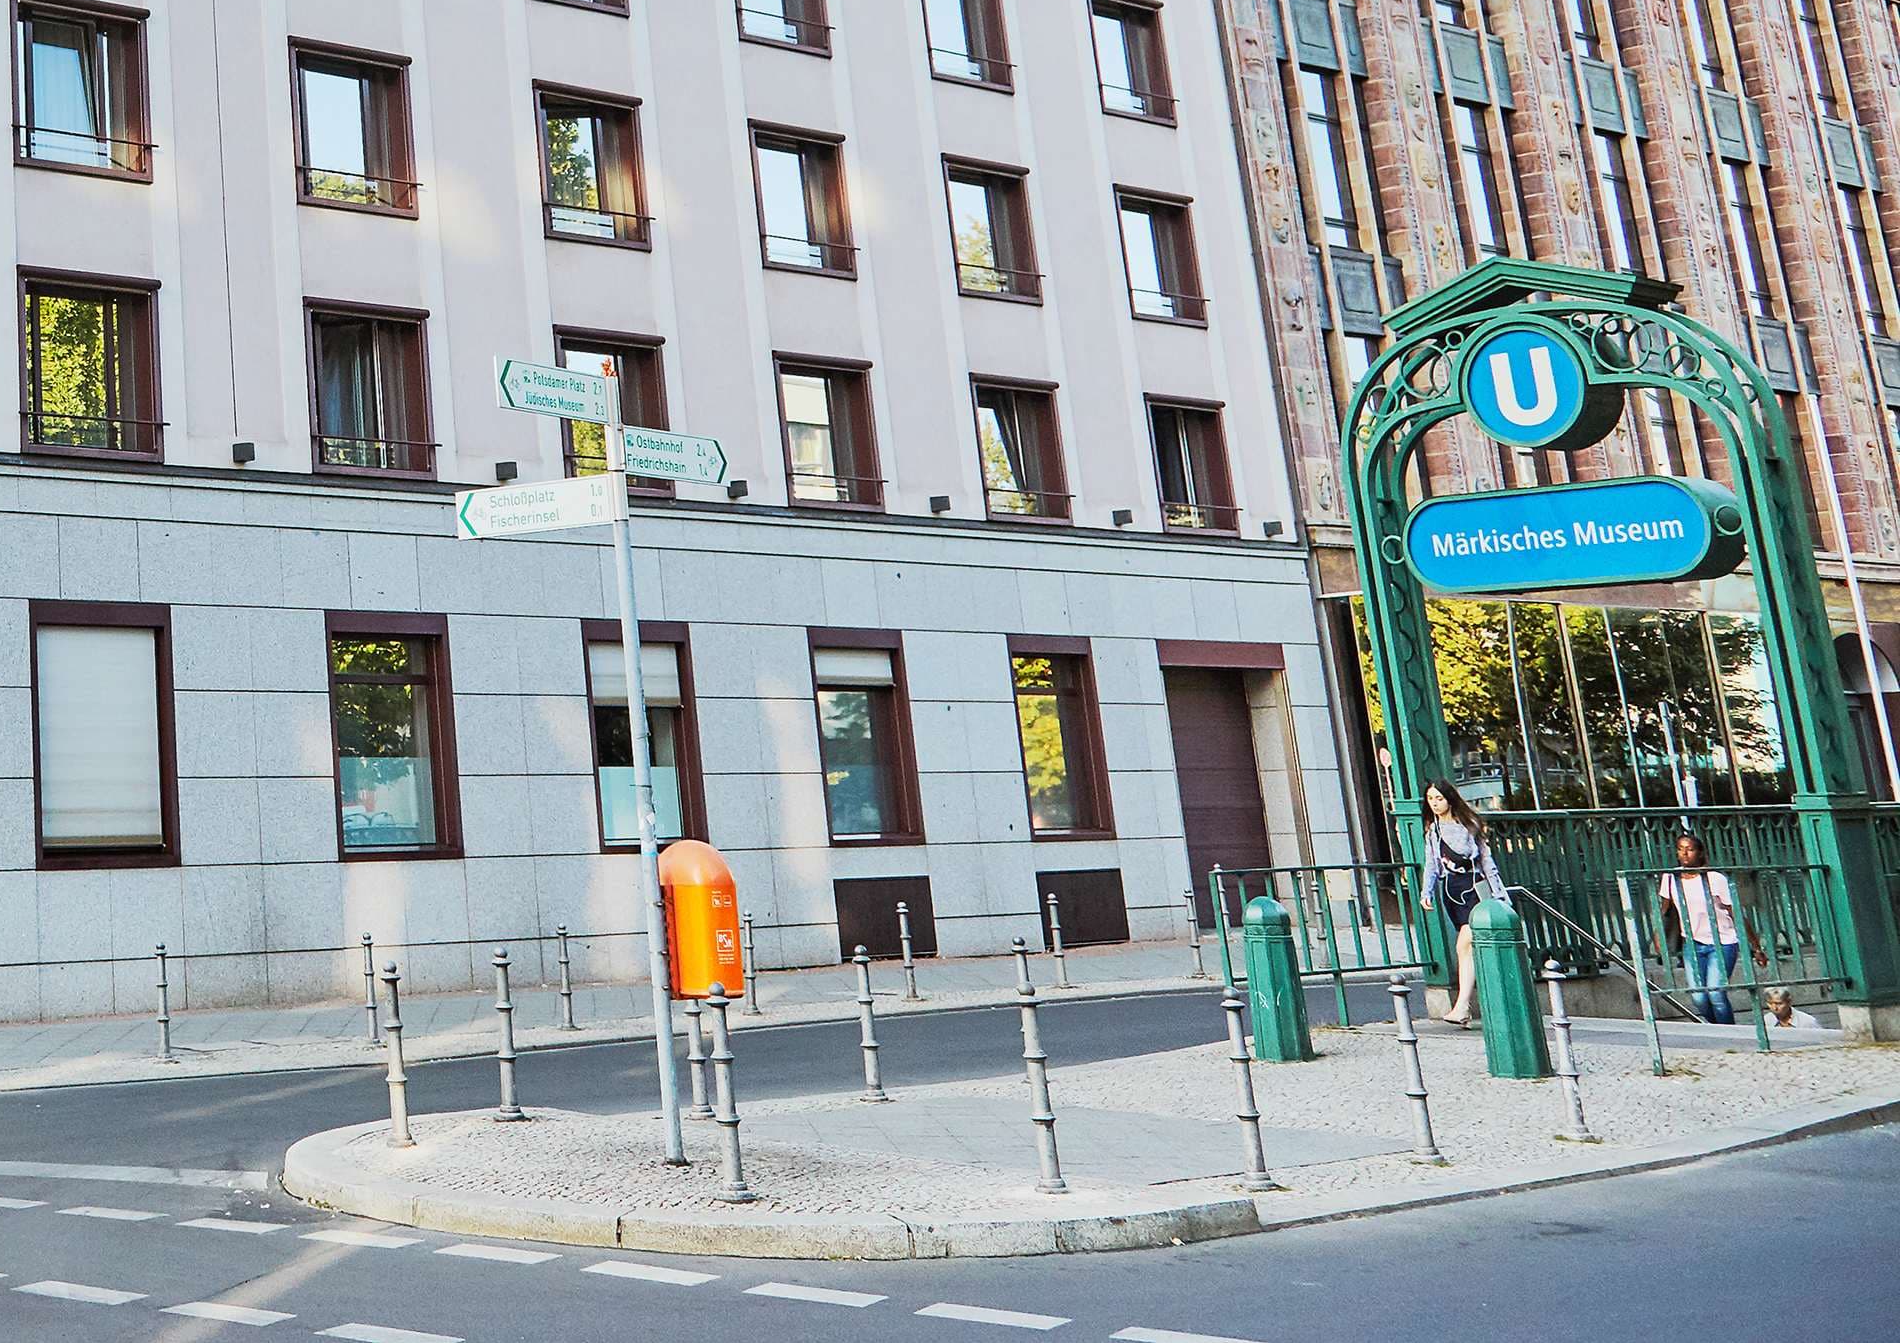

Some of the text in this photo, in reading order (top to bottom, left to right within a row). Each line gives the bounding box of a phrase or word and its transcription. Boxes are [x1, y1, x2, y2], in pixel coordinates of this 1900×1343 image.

[533, 370, 568, 390] Potsdamer
[569, 377, 586, 393] Platz
[1488, 346, 1559, 427] U
[525, 391, 557, 409] Jüdisches
[636, 435, 683, 454] Ostbahnhof
[627, 453, 686, 473] Friedrichshain
[489, 491, 556, 509] Schloßplatz
[490, 508, 560, 529] Fischerinsel
[1431, 518, 1685, 557] Märkisches Museum
